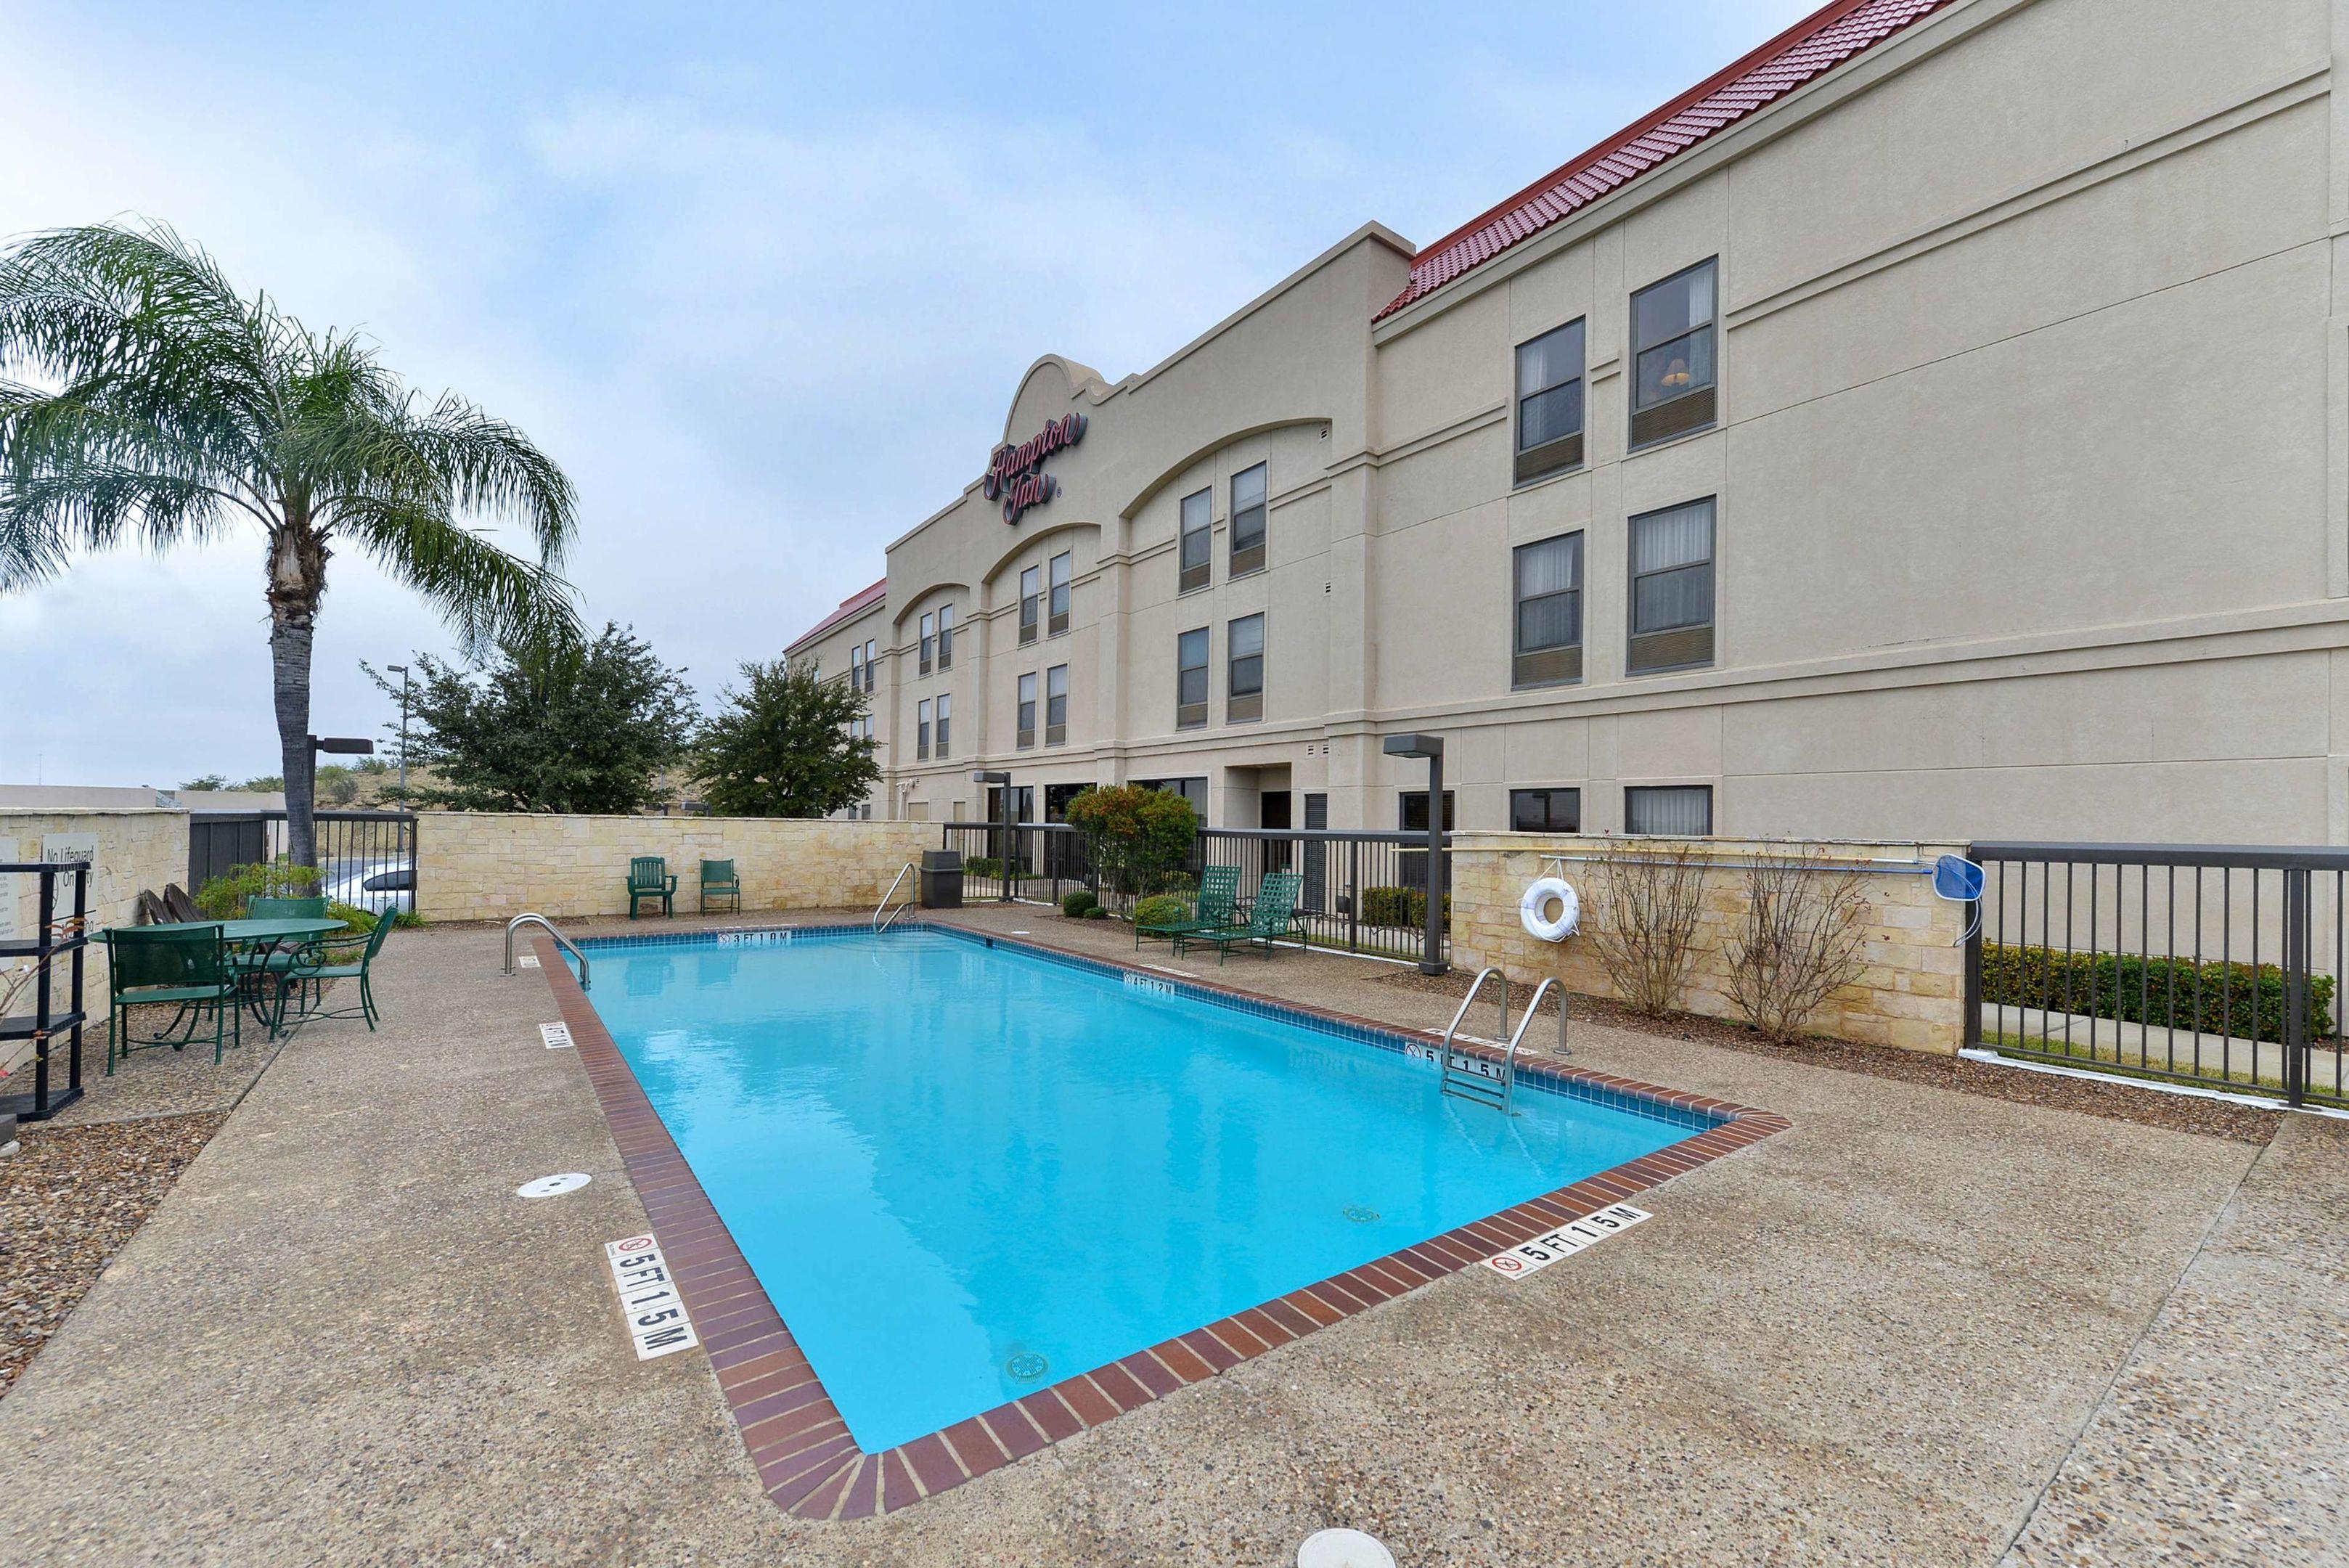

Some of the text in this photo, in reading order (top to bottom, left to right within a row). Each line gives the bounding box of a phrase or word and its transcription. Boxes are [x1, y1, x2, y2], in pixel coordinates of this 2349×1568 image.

[984, 412, 1087, 501] Hampton
[1002, 473, 1056, 526] Inn
[47, 845, 94, 862] No Lifeguard
[744, 934, 754, 942] FT
[1426, 1050, 1434, 1062] 5
[1519, 1246, 1551, 1260] 5
[1540, 1234, 1578, 1253] FT
[1608, 1207, 1641, 1221] M
[619, 1254, 656, 1267] 5
[624, 1267, 665, 1286] FT
[644, 1327, 687, 1349] M
